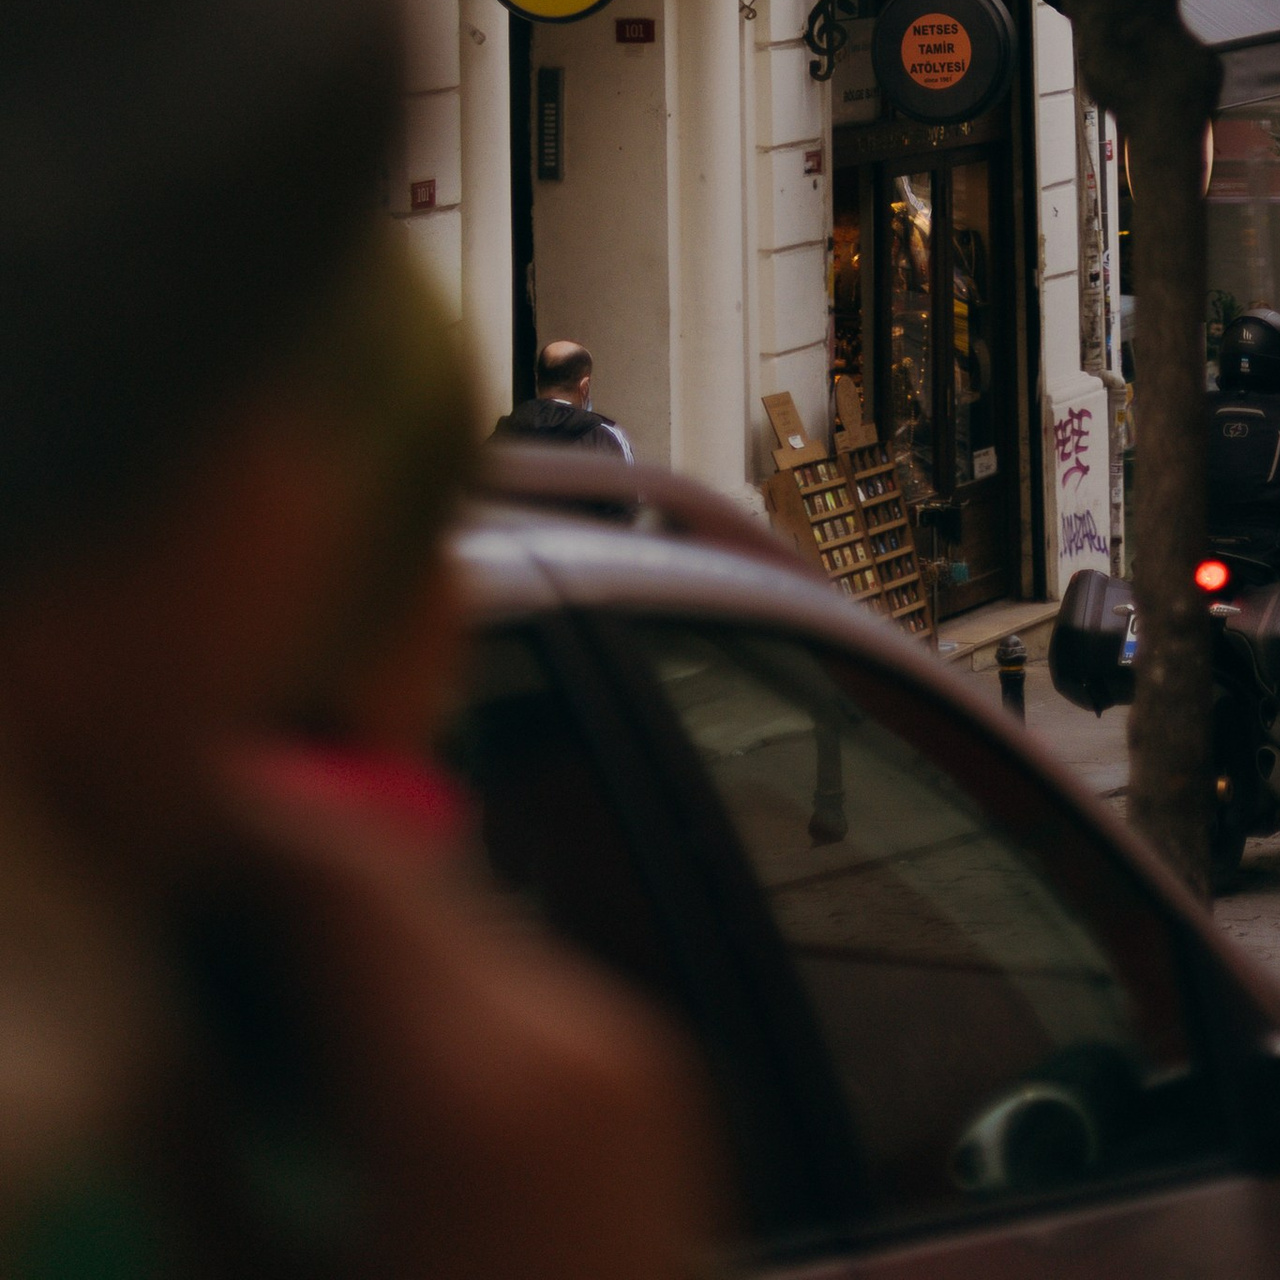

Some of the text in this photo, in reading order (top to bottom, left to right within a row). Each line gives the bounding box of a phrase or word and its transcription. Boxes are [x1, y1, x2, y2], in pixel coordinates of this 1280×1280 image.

[624, 23, 644, 39] 101
[913, 23, 959, 36] NETSES
[918, 40, 955, 55] TAMİR
[910, 58, 965, 74] ATÖLYESİ
